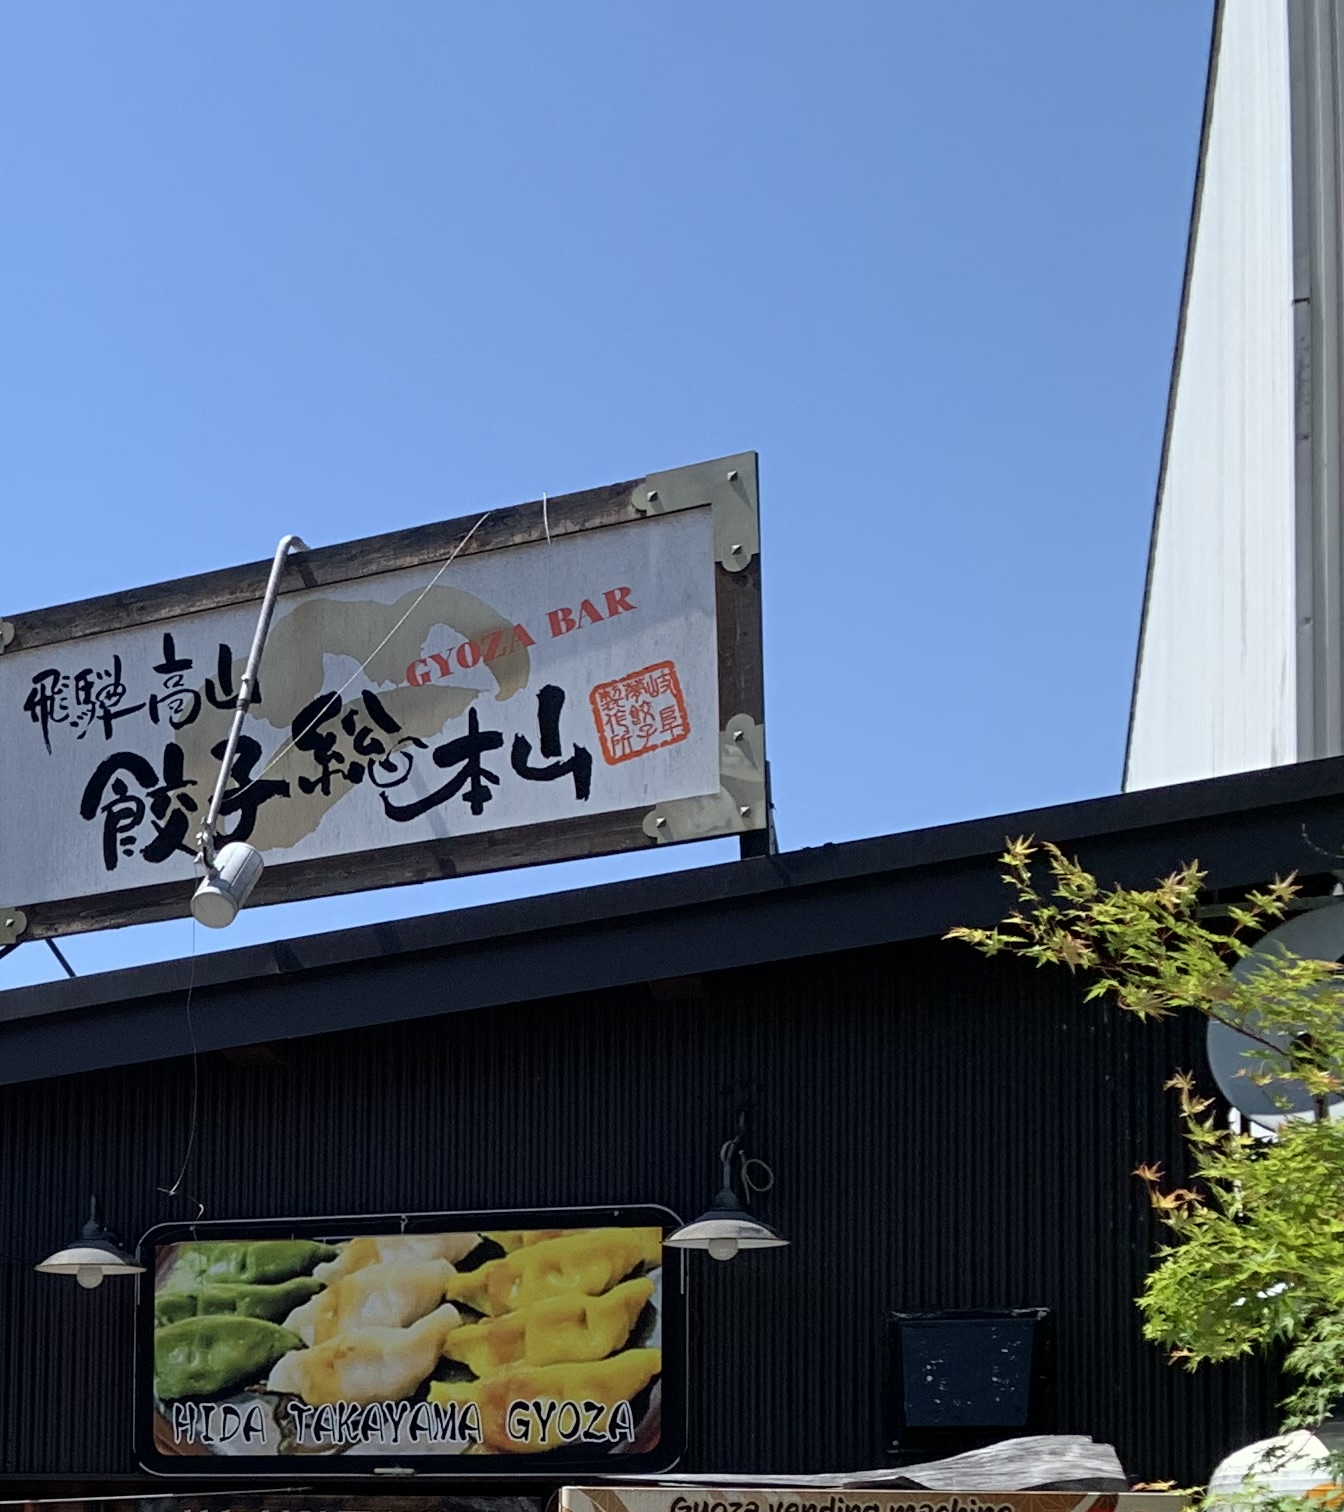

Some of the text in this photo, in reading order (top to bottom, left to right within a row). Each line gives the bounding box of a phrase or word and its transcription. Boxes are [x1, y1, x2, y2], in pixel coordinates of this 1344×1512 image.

[405, 586, 637, 687] GYOZA BAR
[24, 633, 261, 755] 飛騨高山
[80, 684, 592, 870] 餃子総本山
[172, 1399, 635, 1444] HIDA TAKAYAMA GYOZA
